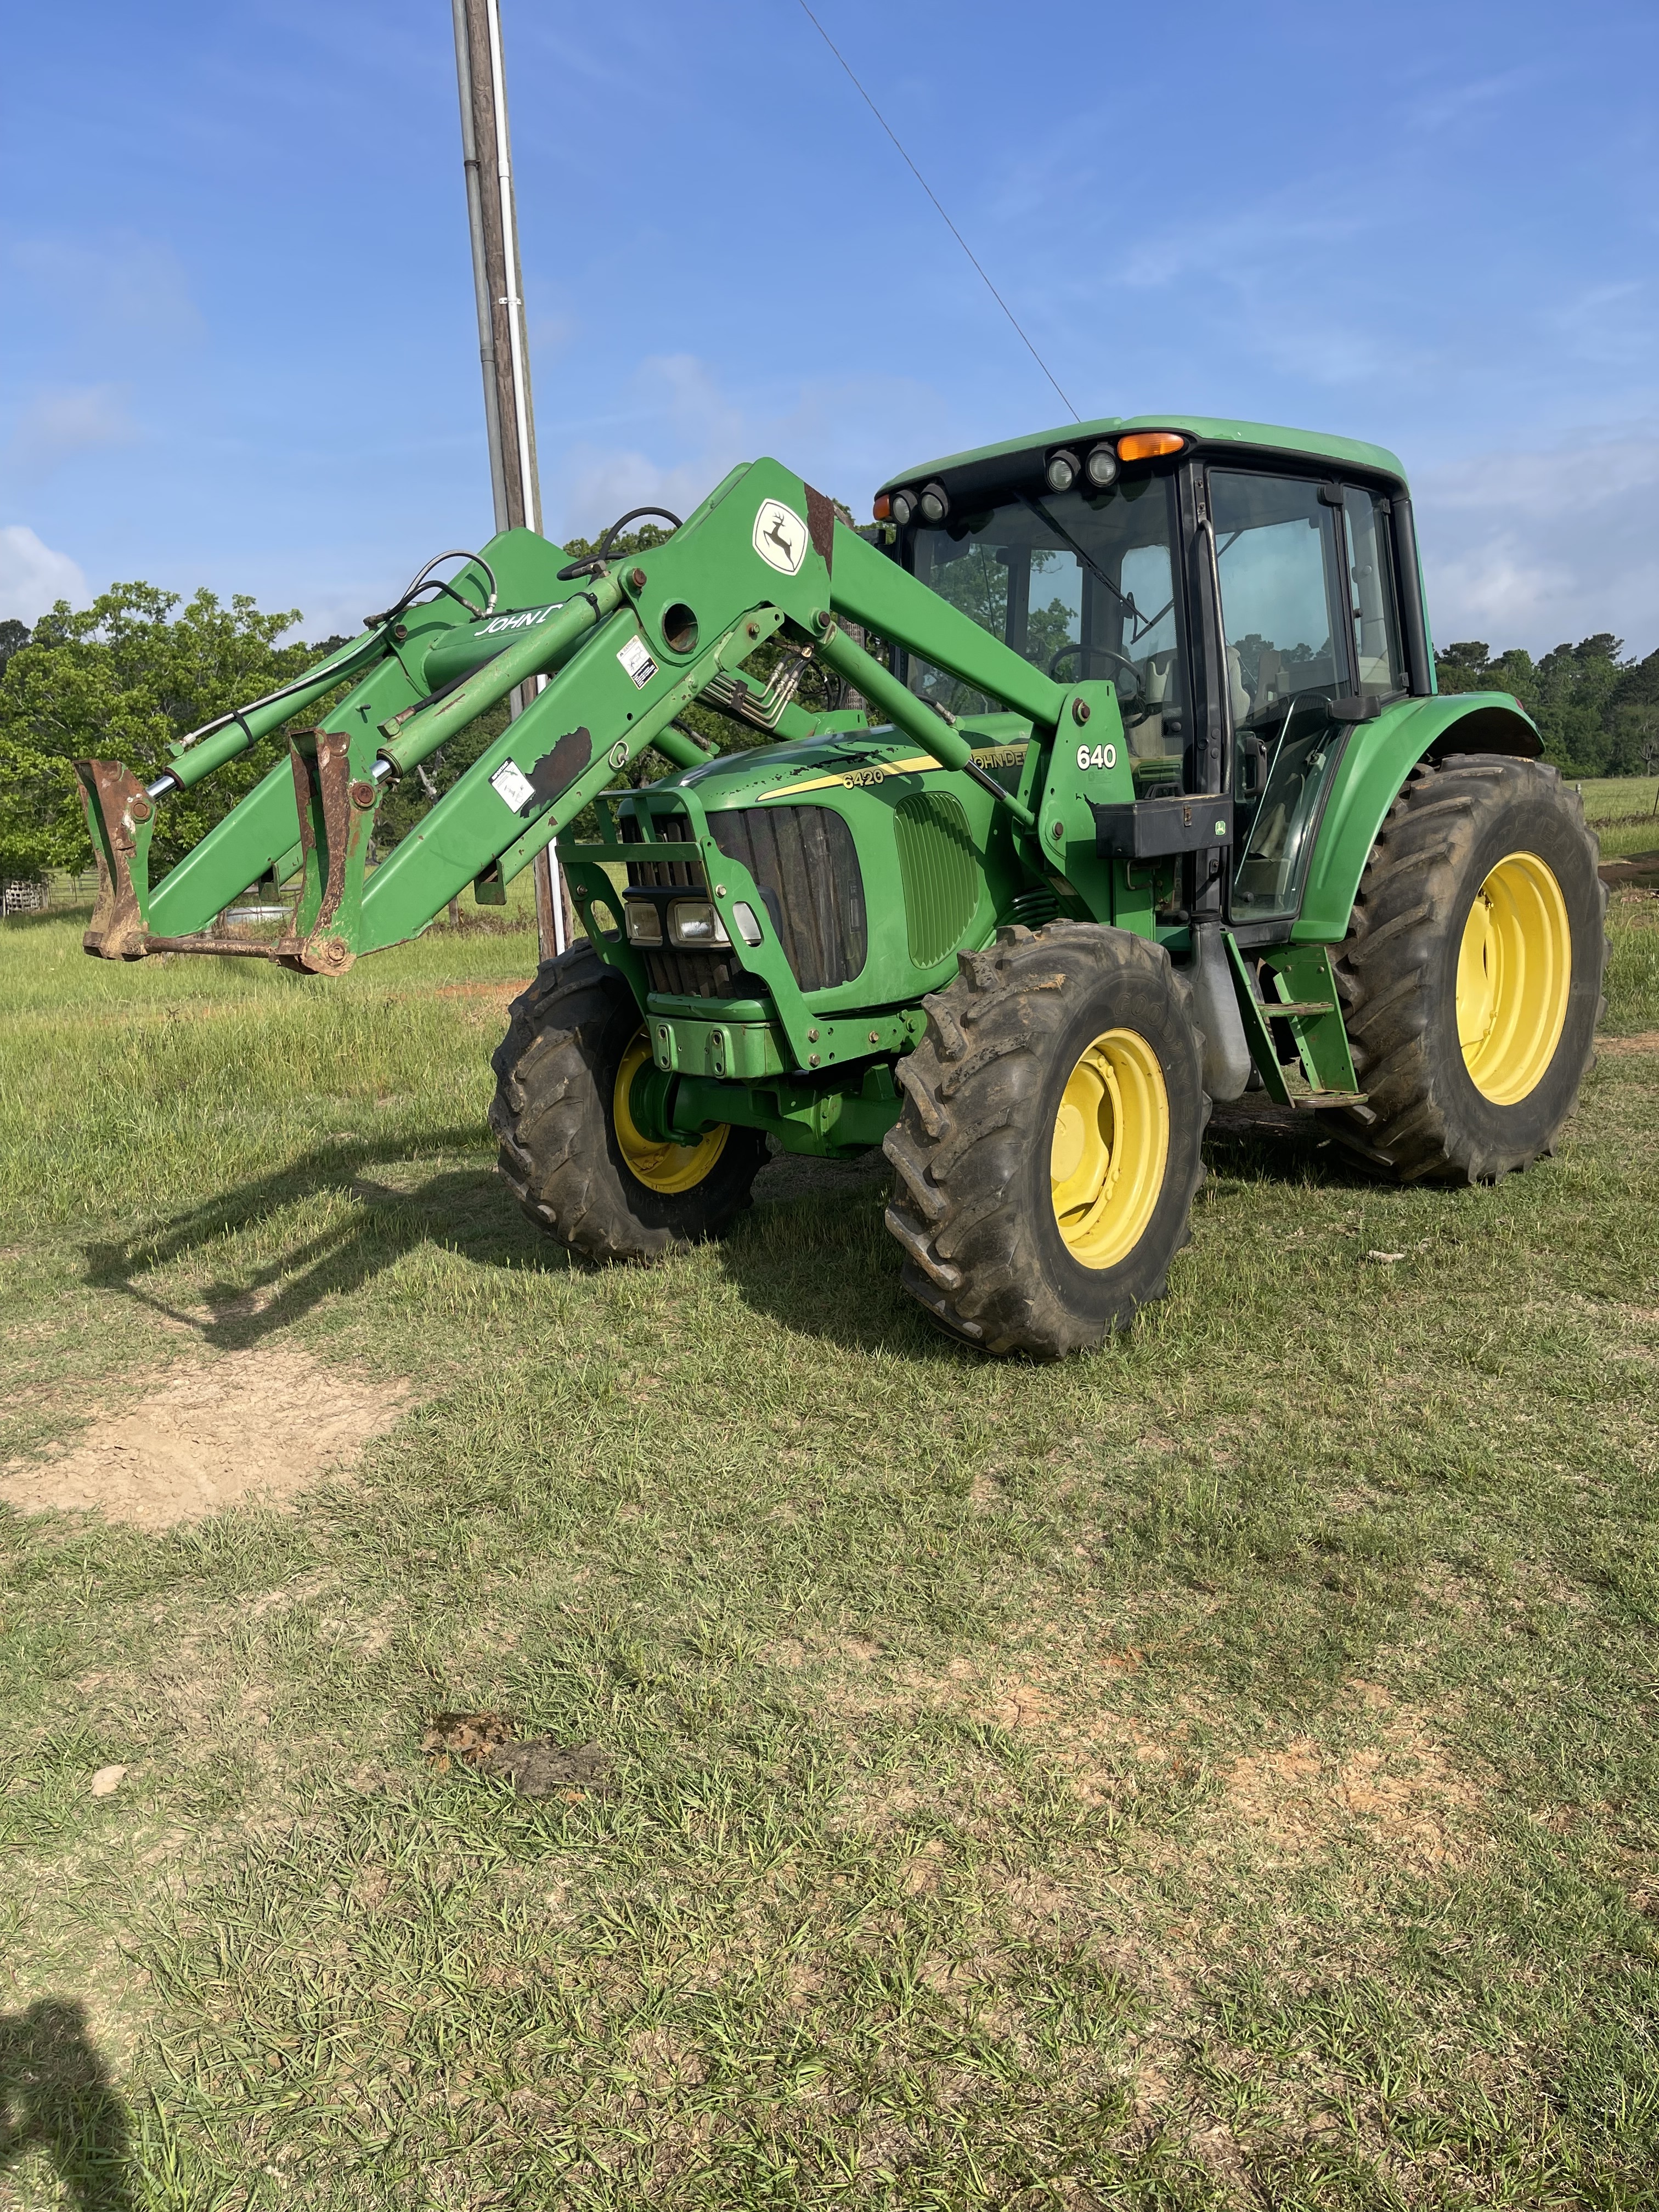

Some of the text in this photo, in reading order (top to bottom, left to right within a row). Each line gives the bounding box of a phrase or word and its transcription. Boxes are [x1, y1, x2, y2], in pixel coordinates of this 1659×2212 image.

[473, 610, 542, 636] JOHN
[970, 753, 1004, 769] OHN
[1076, 743, 1116, 771] 640
[843, 769, 884, 789] 6420
